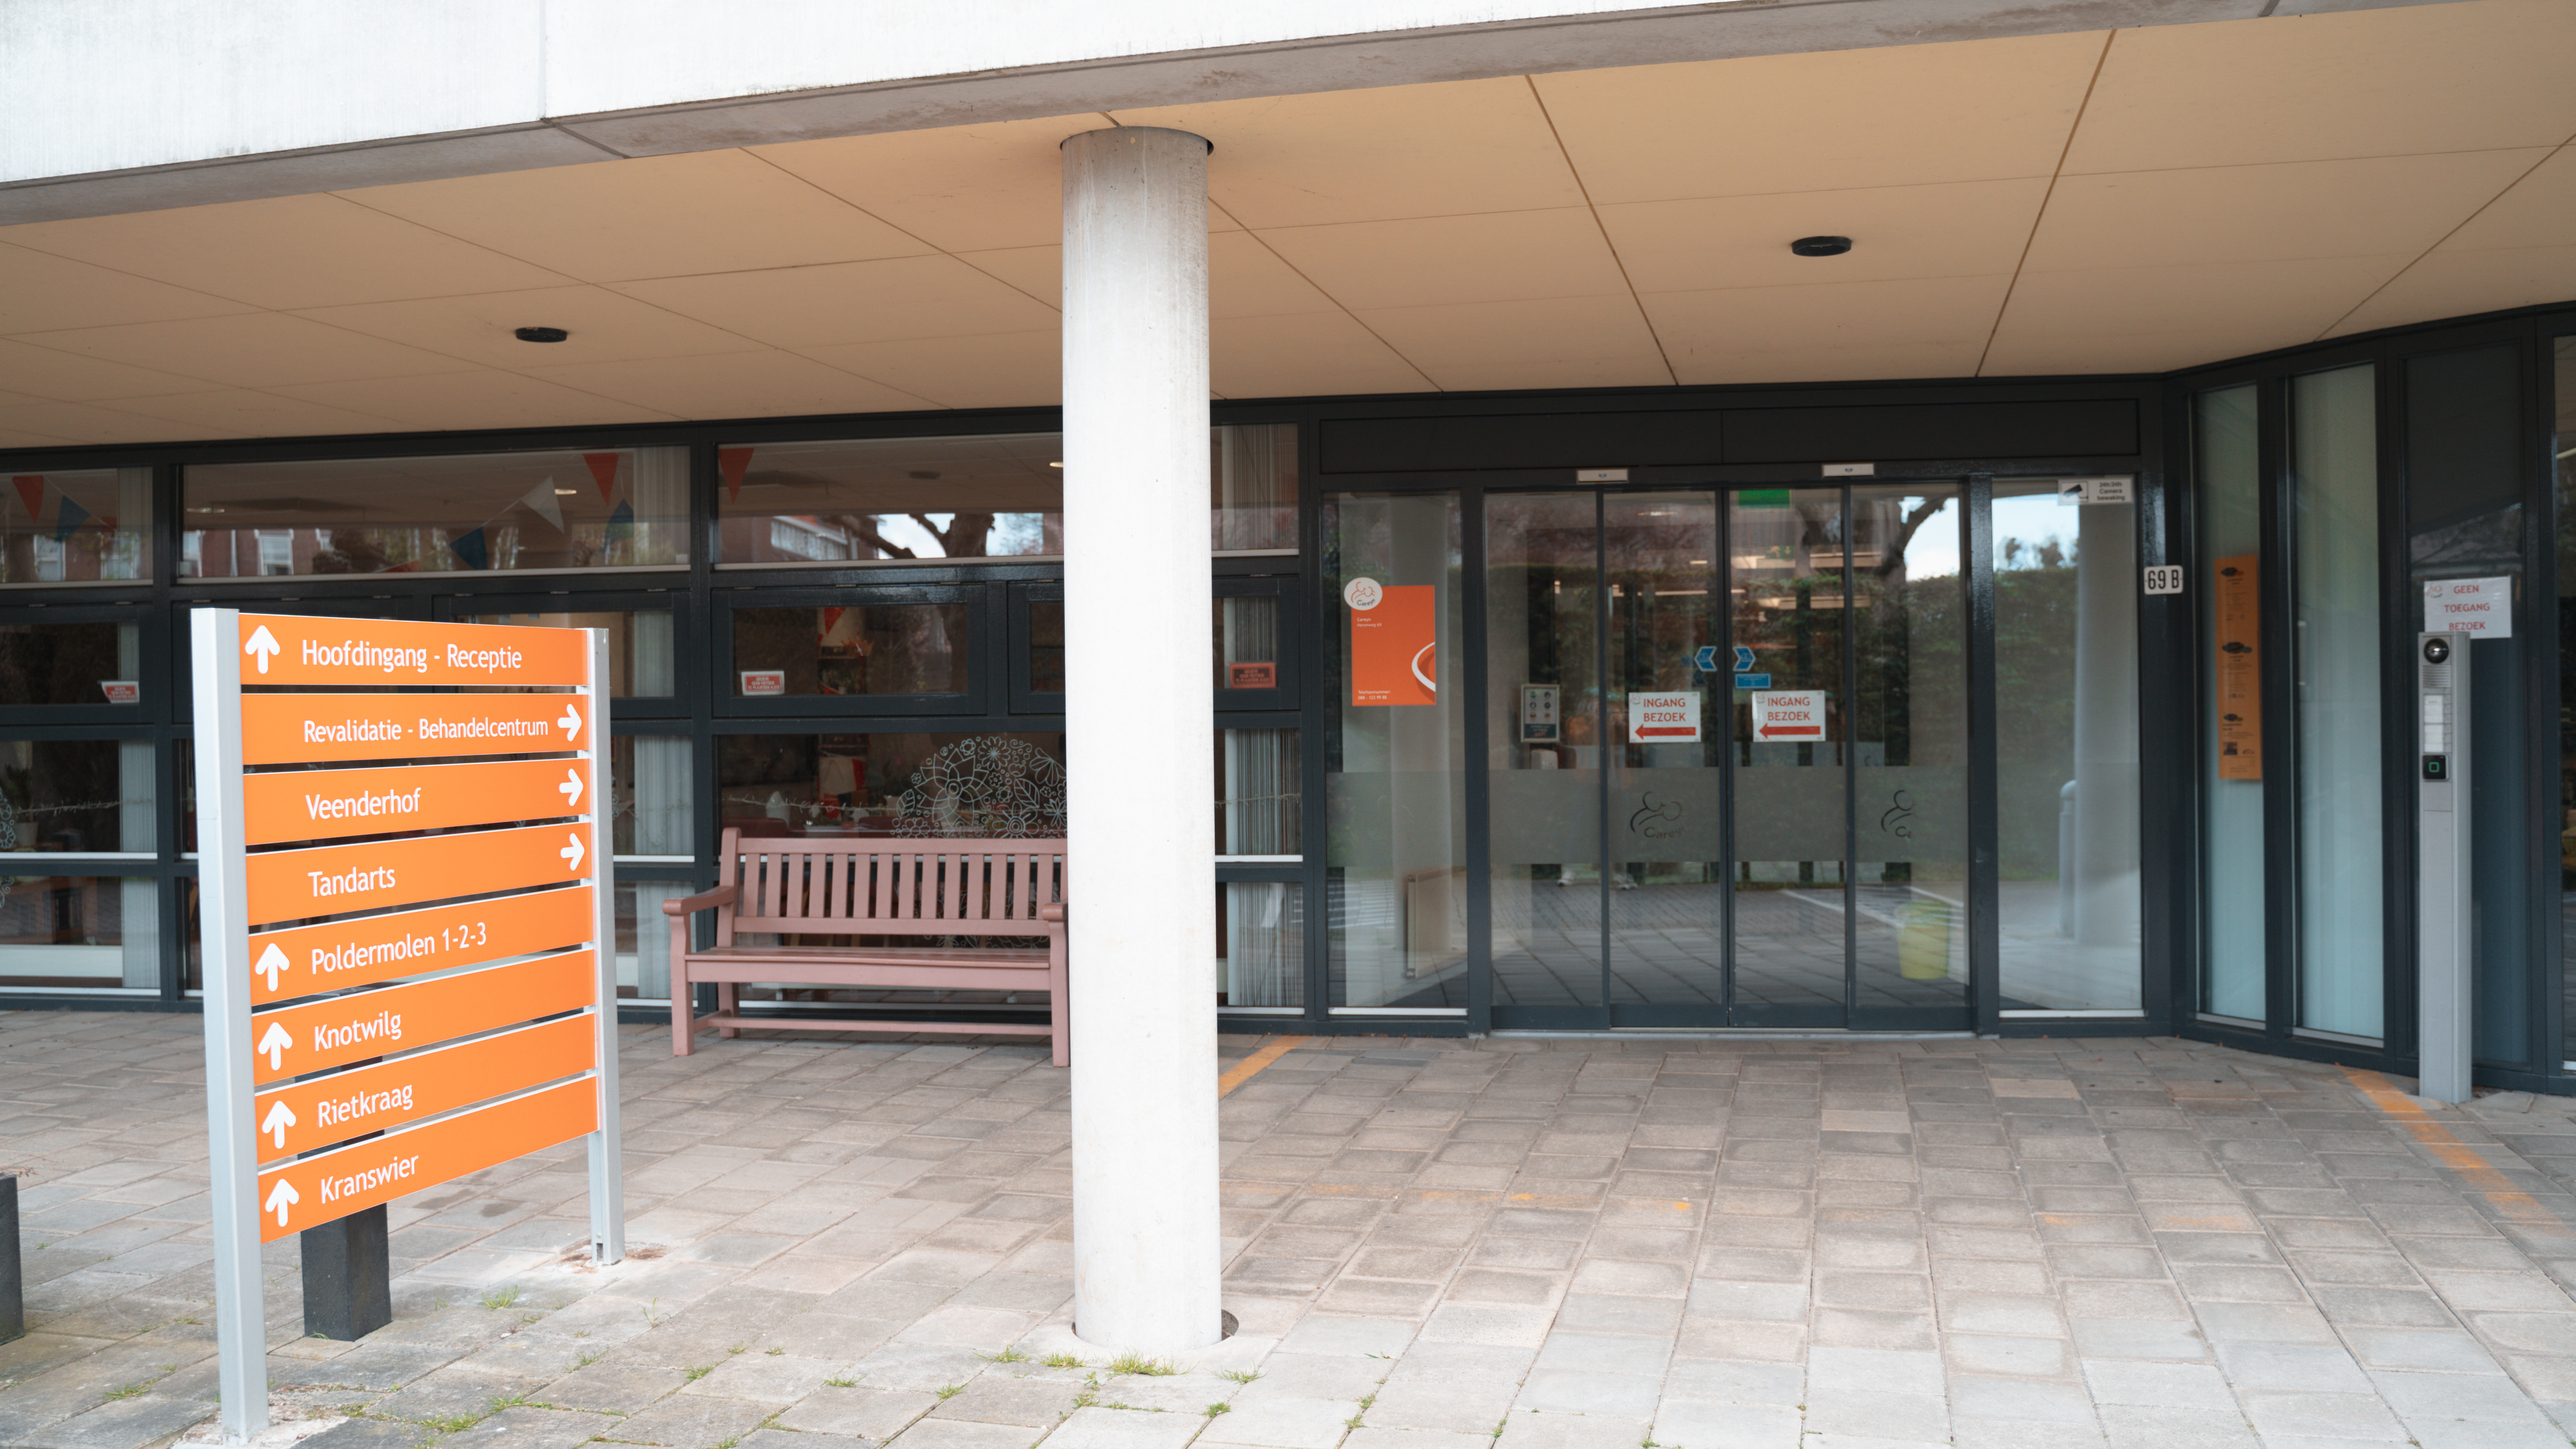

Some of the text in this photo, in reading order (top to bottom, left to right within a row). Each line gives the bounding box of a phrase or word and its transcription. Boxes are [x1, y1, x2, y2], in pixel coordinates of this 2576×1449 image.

[2148, 569, 2179, 589] 69 B
[2454, 585, 2479, 594] GEEN
[2444, 602, 2490, 612] TOEGANG
[2448, 621, 2485, 631] BEZOEK
[302, 639, 428, 673] Hoofdingang
[447, 643, 522, 674] Receptie
[1643, 698, 1686, 707] INGANG
[1768, 697, 1810, 706] INGANG
[1643, 712, 1686, 722] BEZOEK
[1768, 711, 1810, 721] BEZOEK
[304, 718, 402, 743] Revalidatie
[419, 717, 548, 739] Behandelcentrum
[305, 787, 422, 820] Veenderhof
[307, 866, 396, 897] Tandarts
[311, 922, 486, 975] Poldermolen 1-2-3
[314, 1010, 402, 1052] Knotwilg
[318, 1084, 413, 1128] Rietkraag
[321, 1155, 419, 1204] Kranswier
